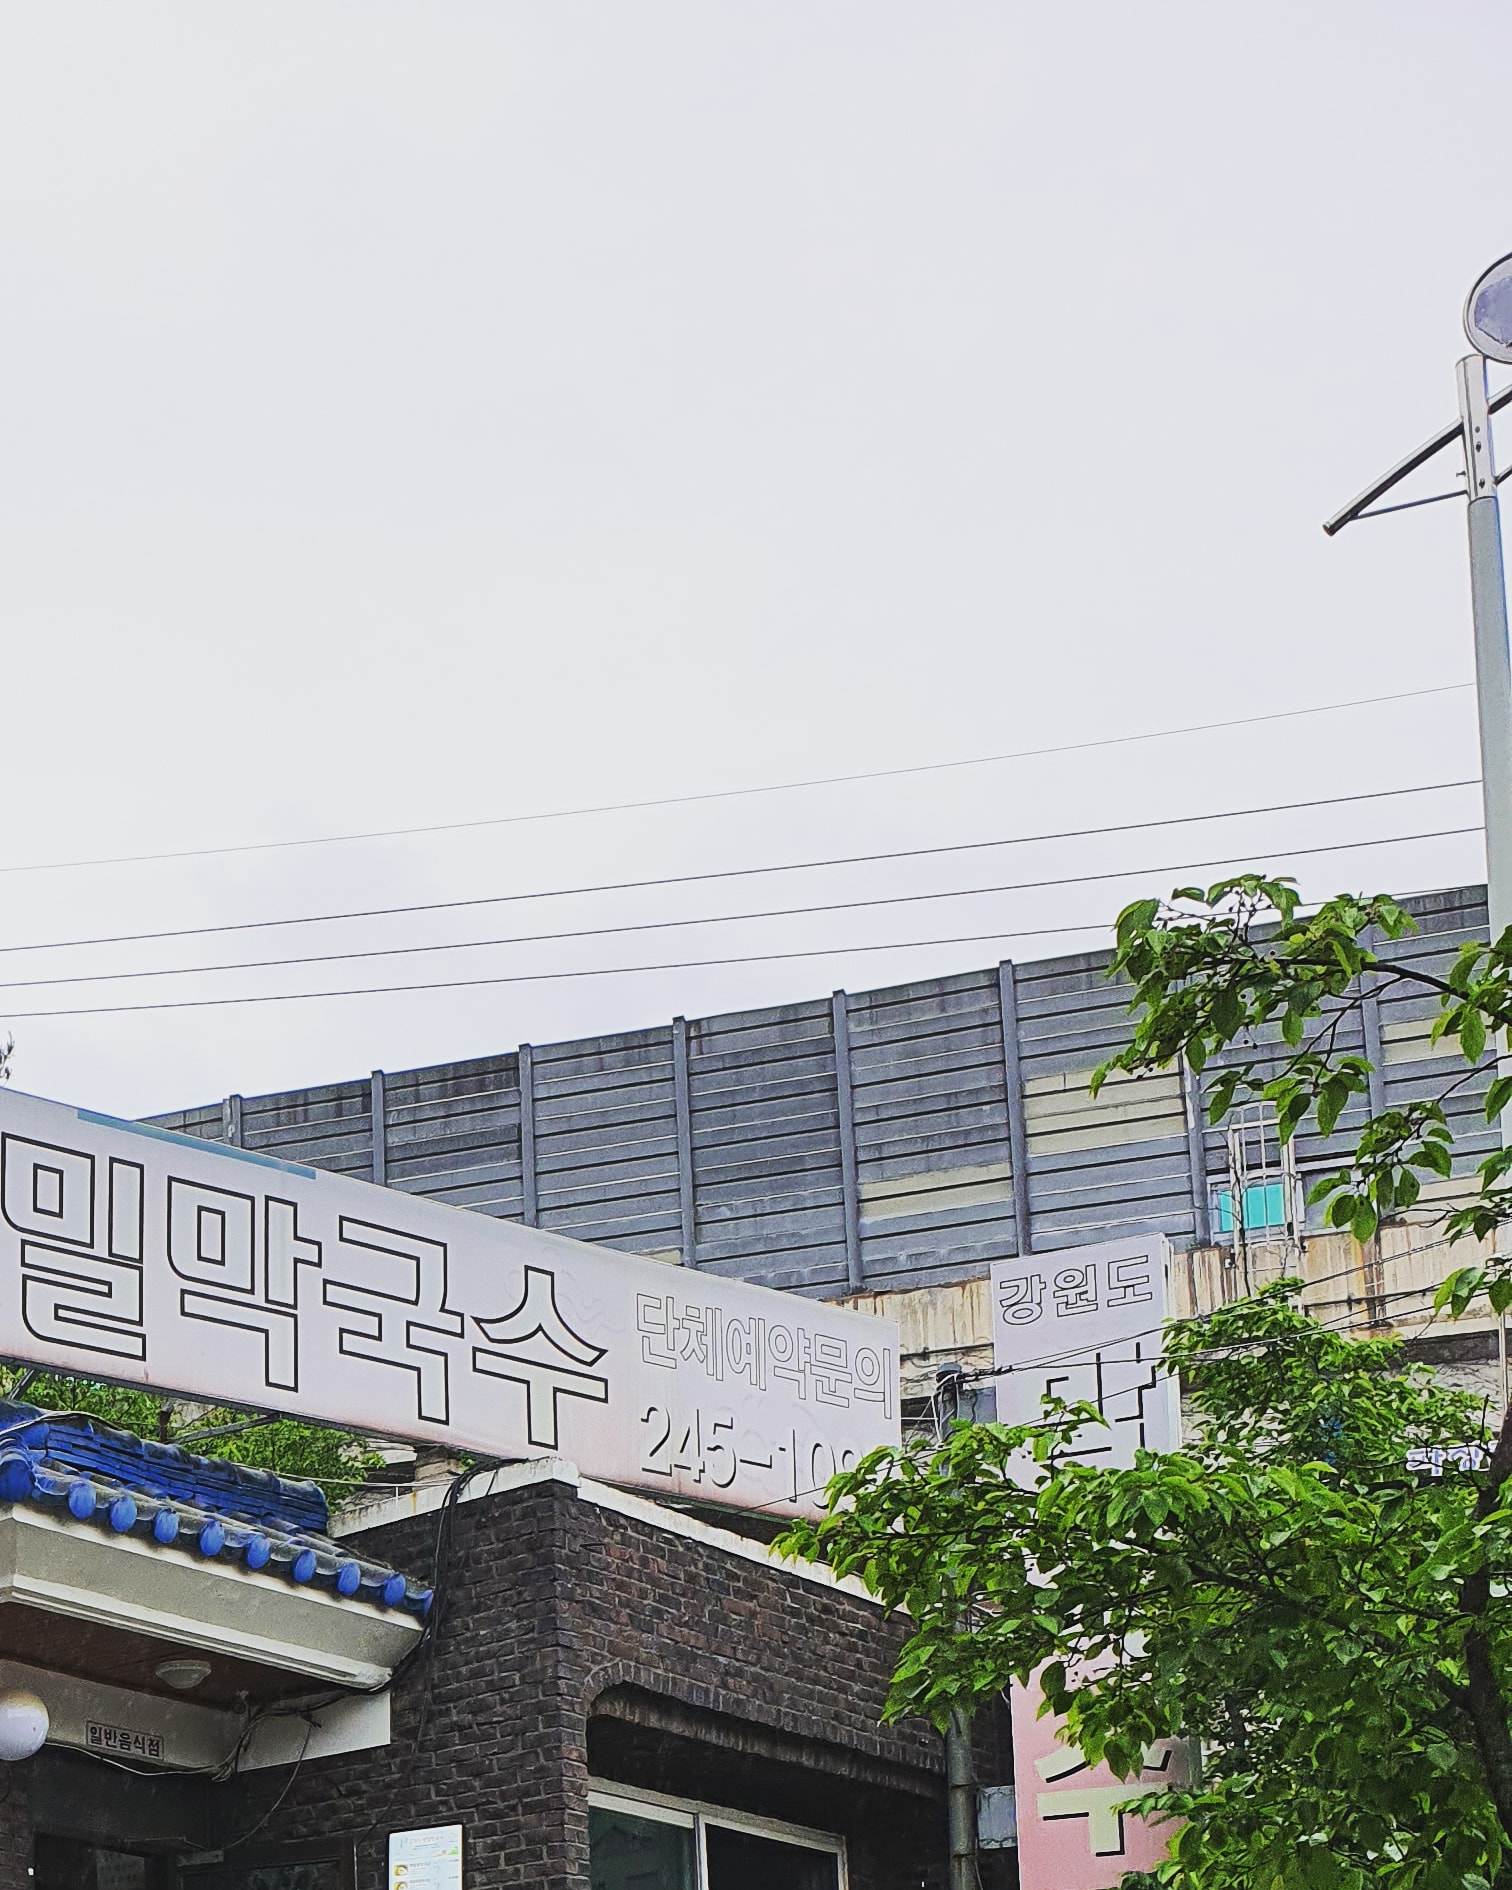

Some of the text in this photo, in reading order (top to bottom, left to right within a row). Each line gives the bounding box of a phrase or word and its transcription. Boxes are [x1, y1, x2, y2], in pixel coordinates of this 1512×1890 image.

[999, 1254, 1153, 1326] 강원도
[636, 1292, 893, 1420] 단체예약문의
[90, 1726, 160, 1757] 일반음식점
